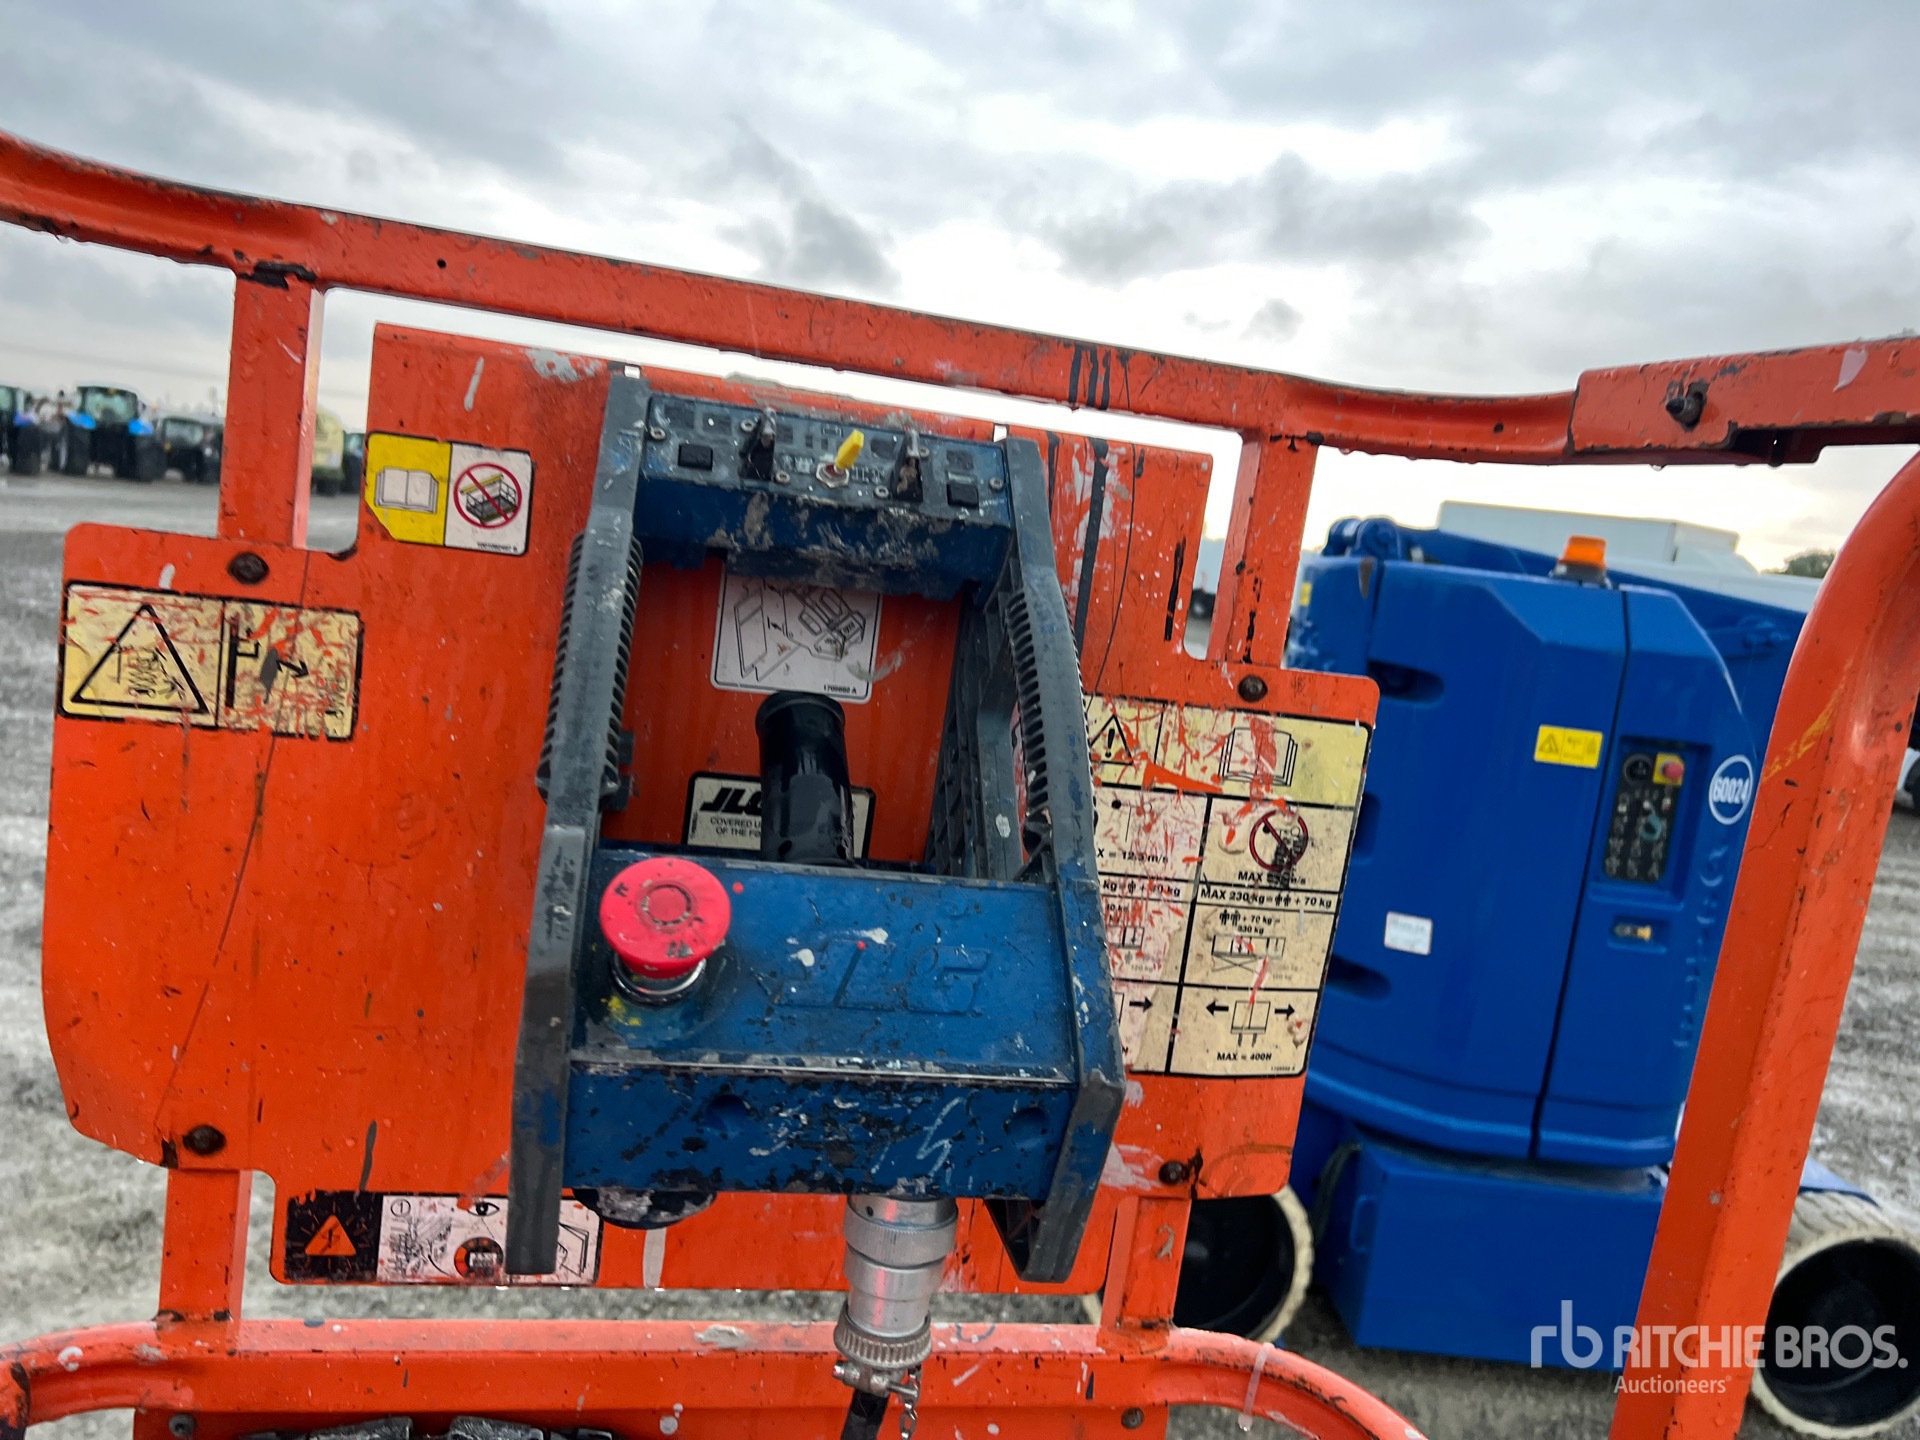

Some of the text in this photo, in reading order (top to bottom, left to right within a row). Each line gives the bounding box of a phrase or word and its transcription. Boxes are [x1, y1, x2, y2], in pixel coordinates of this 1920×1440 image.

[1713, 776, 1750, 804] 60024
[710, 816, 752, 828] COVERED
[716, 826, 728, 835] OF
[730, 828, 747, 837] THE
[1238, 870, 1263, 882] MAX
[1103, 880, 1118, 893] kg
[1201, 888, 1227, 900] MAX
[1229, 890, 1249, 901] 230
[1304, 897, 1317, 906] 70
[1320, 898, 1332, 909] kg
[1250, 914, 1261, 924] 70
[1262, 915, 1273, 926] kg
[1216, 1052, 1238, 1061] MAX
[1250, 1053, 1273, 1061] 400N
